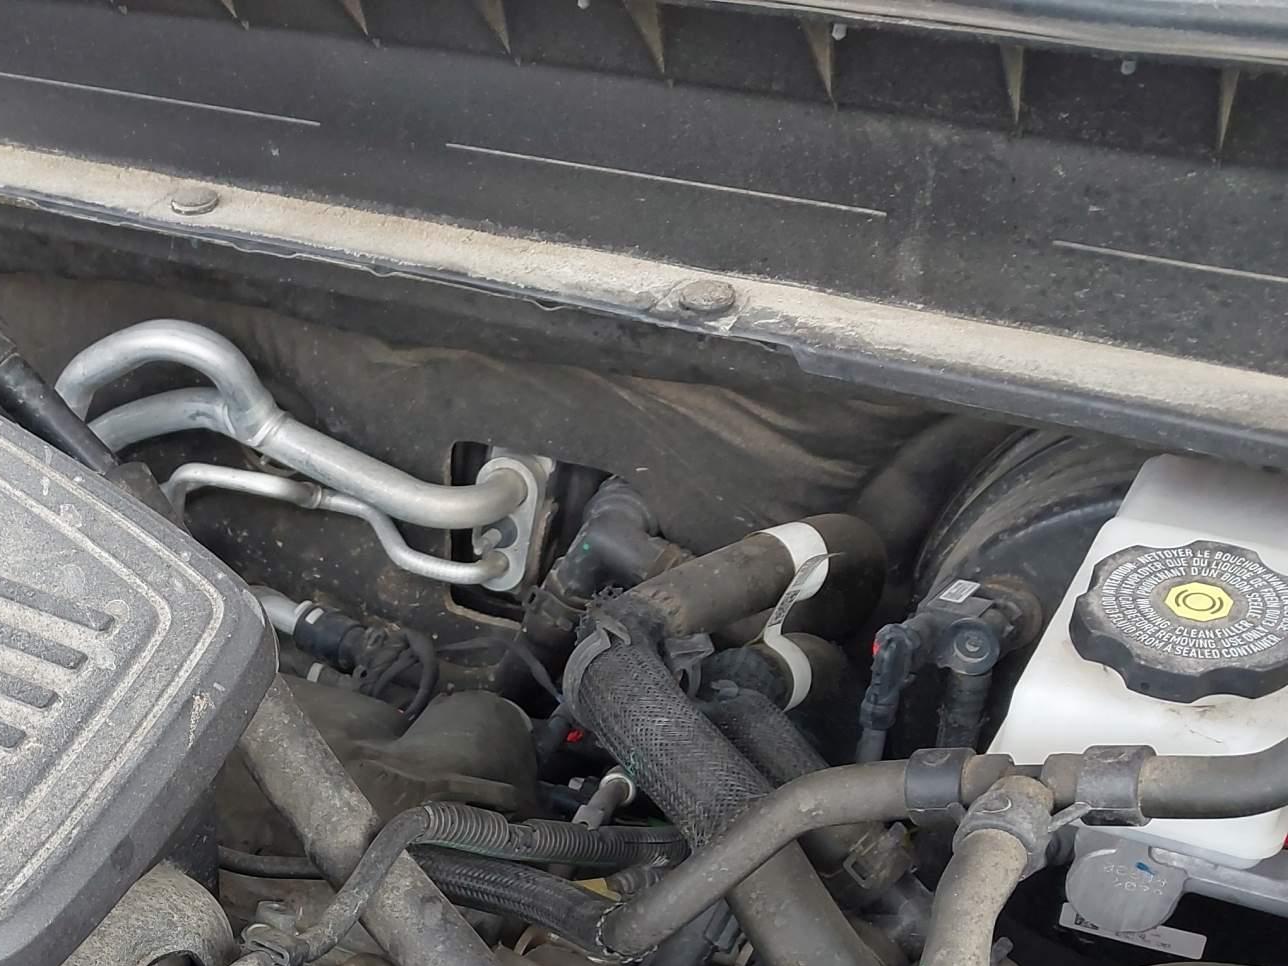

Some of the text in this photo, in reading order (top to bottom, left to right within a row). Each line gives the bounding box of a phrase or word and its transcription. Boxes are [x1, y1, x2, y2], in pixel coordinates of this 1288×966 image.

[1137, 548, 1193, 564] NETTOYER
[1197, 549, 1211, 558] LE
[1214, 551, 1267, 575] BOUCHON
[1136, 567, 1186, 596] PROVENANT
[1220, 572, 1254, 593] BIDON
[1166, 558, 1189, 568] QUE
[1192, 557, 1208, 567] DU
[1212, 560, 1254, 579] LIQUIDE
[1250, 577, 1268, 589] DE
[1260, 587, 1281, 608] FREIN
[1107, 613, 1137, 633] FLUID
[1132, 631, 1165, 650] FROM
[1162, 644, 1173, 653] A
[1174, 645, 1220, 659] SEALED
[1124, 609, 1159, 635] BEFORE
[1221, 636, 1246, 648] USE
[1242, 625, 1269, 642] ONLY
[1175, 626, 1215, 639] CLEAN
[1215, 620, 1254, 638] FILLER
